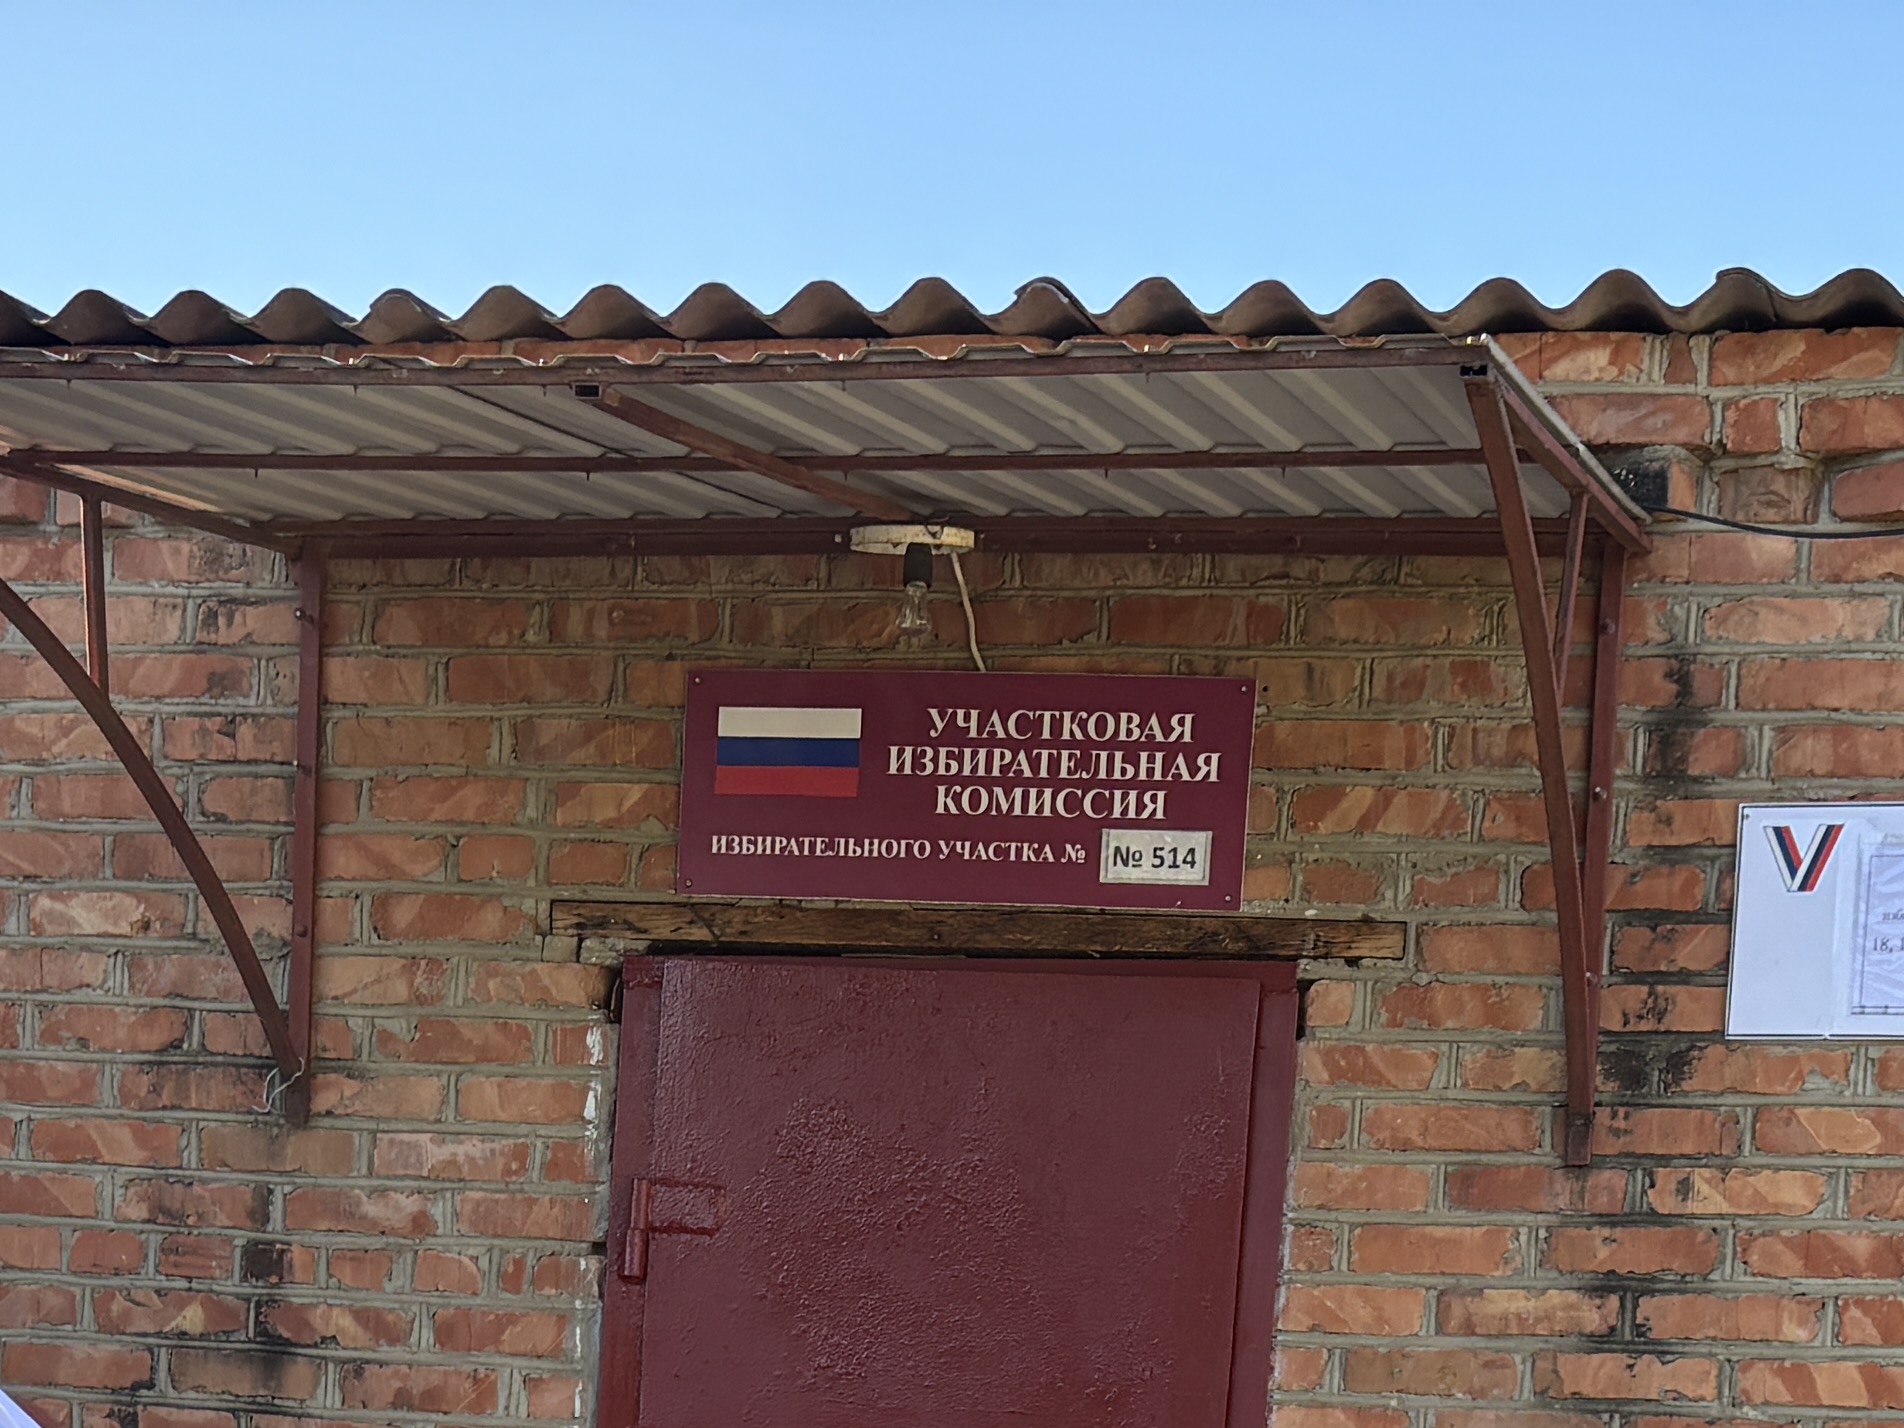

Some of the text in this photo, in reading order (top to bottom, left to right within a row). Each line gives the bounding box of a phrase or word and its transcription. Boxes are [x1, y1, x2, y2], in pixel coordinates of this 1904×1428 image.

[927, 707, 1196, 744] УЧАСТКОВАЯ
[886, 745, 1221, 783] ИЗБИРАТЕЛЬНАЯ
[934, 785, 1168, 820] КОМИССИЯ
[711, 834, 1087, 864] ИЗБИРАТЕЛЬНОГО УЧАСТКА №
[1112, 845, 1197, 870] № 514
[1872, 936, 1894, 953] 18,
